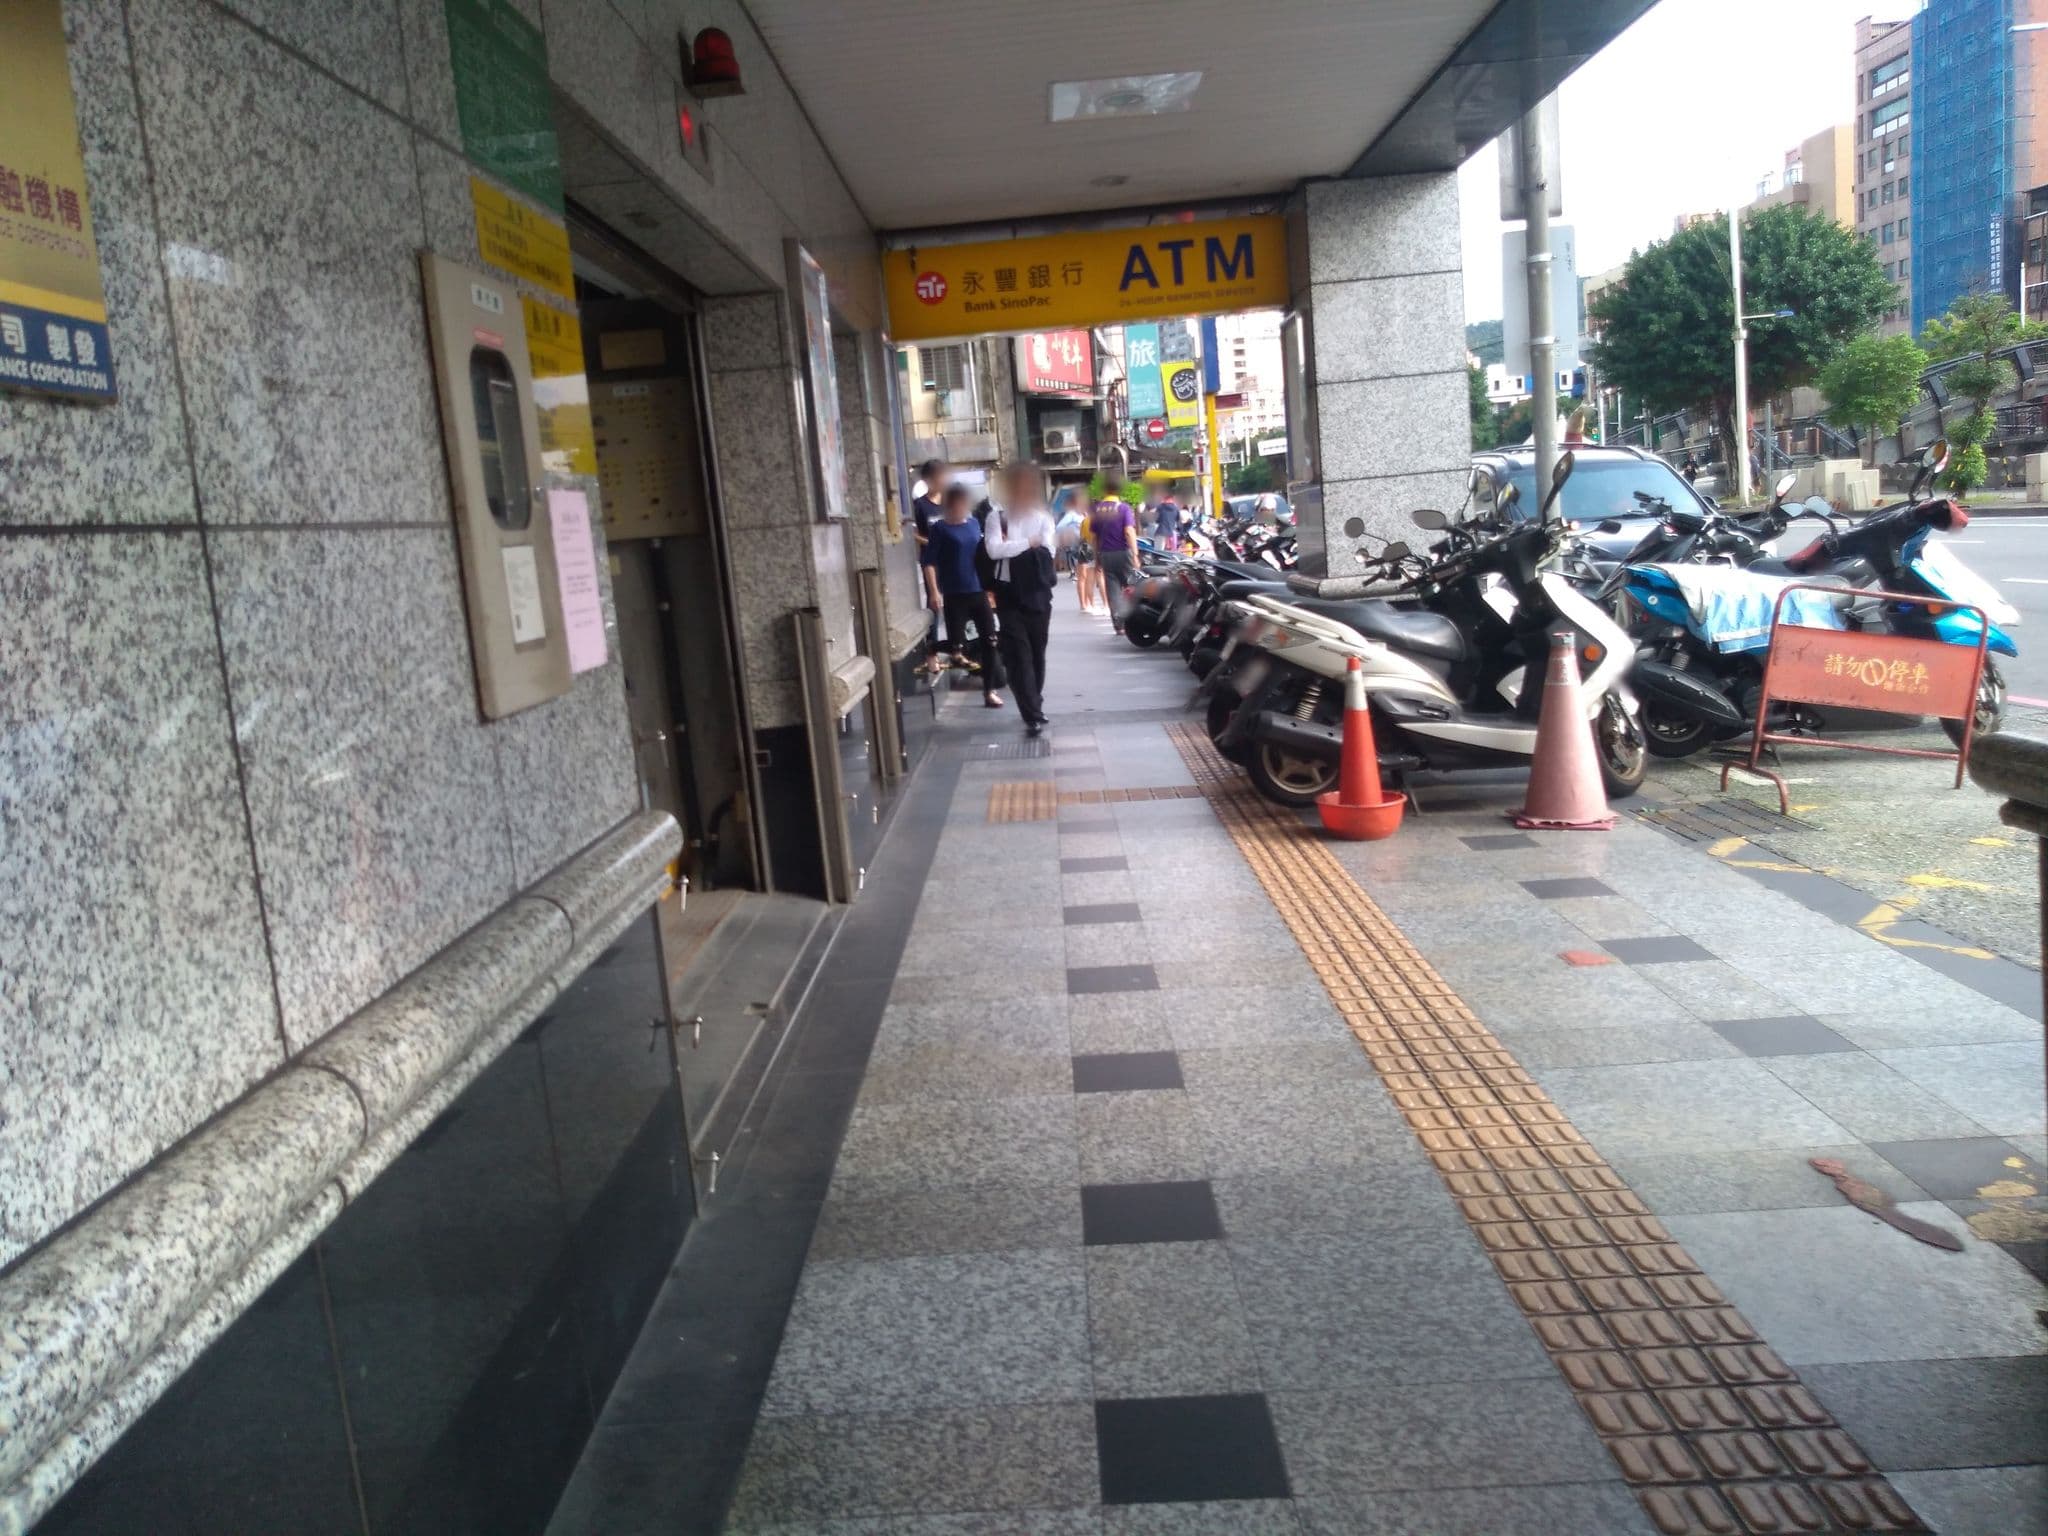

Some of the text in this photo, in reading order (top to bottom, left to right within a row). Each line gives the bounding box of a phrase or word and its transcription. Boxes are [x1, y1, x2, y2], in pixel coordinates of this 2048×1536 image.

[1119, 233, 1255, 292] ATM
[962, 261, 1083, 295] 永豐銀行
[965, 295, 1051, 313] Bank SinoPac
[1129, 339, 1157, 368] 旅
[30, 361, 108, 391] CORPORATION
